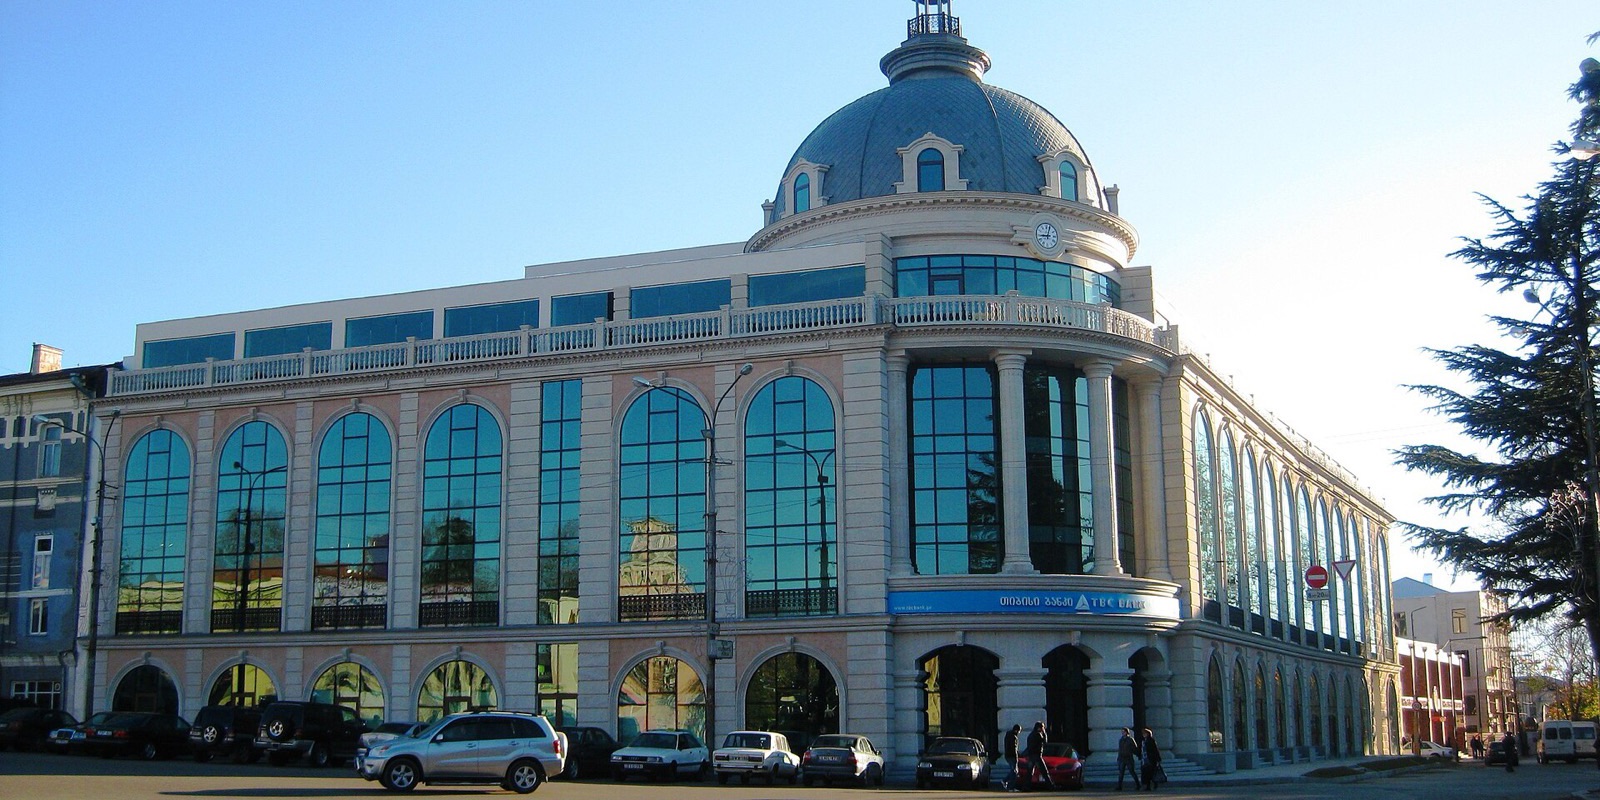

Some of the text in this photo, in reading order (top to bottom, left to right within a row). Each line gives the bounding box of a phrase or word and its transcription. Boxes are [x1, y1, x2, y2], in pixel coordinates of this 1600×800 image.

[1000, 596, 1040, 606] თიბისი
[1091, 597, 1146, 609] TBC BANK
